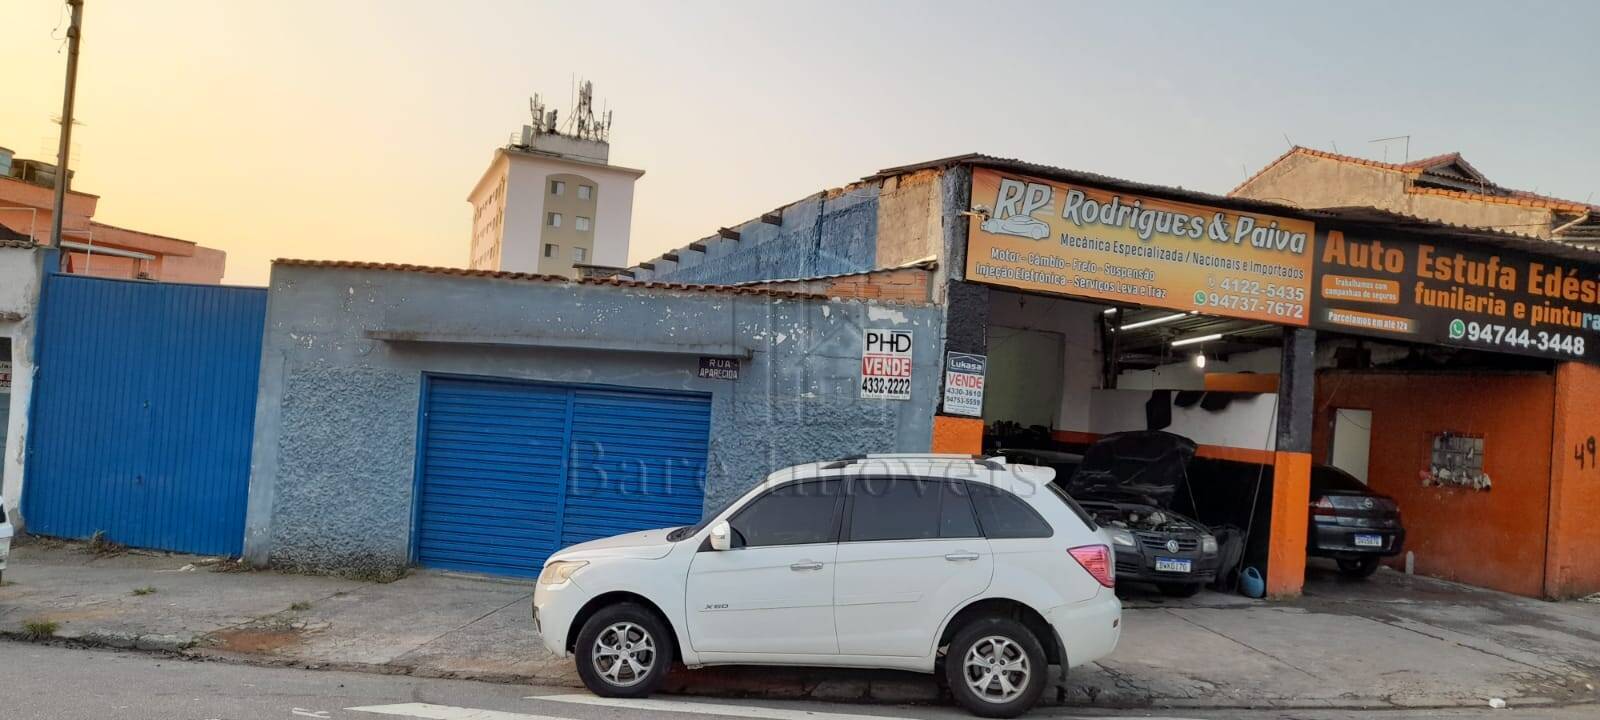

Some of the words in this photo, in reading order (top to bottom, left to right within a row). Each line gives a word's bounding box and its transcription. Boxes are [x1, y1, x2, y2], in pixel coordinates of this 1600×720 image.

[994, 178, 1051, 217] RP
[1063, 189, 1205, 240] Rodrigues
[1208, 211, 1230, 241] &
[1233, 215, 1307, 254] Paiva
[991, 247, 1020, 263] Motor
[1072, 258, 1098, 273] Freio
[1104, 262, 1156, 281] Suspensão
[1060, 233, 1112, 252] Mecânica
[1113, 241, 1184, 263] Especializada
[1192, 252, 1241, 270] Nacionais
[1250, 260, 1304, 280] Importados
[1321, 230, 1404, 274] Auto
[1416, 243, 1517, 292] Estufa
[975, 263, 1014, 280] Injeção
[1015, 266, 1066, 286] Eletrônica
[1073, 275, 1115, 293] Serviços
[1116, 280, 1139, 296] Leva
[1147, 284, 1168, 299] Traz
[1220, 276, 1305, 301] 4122-5435
[1209, 292, 1304, 318] 94737-7672
[1415, 281, 1506, 317] funilaria
[1513, 302, 1526, 319] e
[1531, 301, 1600, 331] pintura
[867, 333, 912, 352] PHD
[1468, 322, 1585, 355] 94744-3448
[699, 367, 738, 379] APARECIDA
[709, 359, 731, 368] RUA
[864, 357, 910, 376] VENDE
[951, 359, 982, 371] Lukasa
[862, 377, 911, 395] 4332-2222
[948, 373, 983, 389] VENDE
